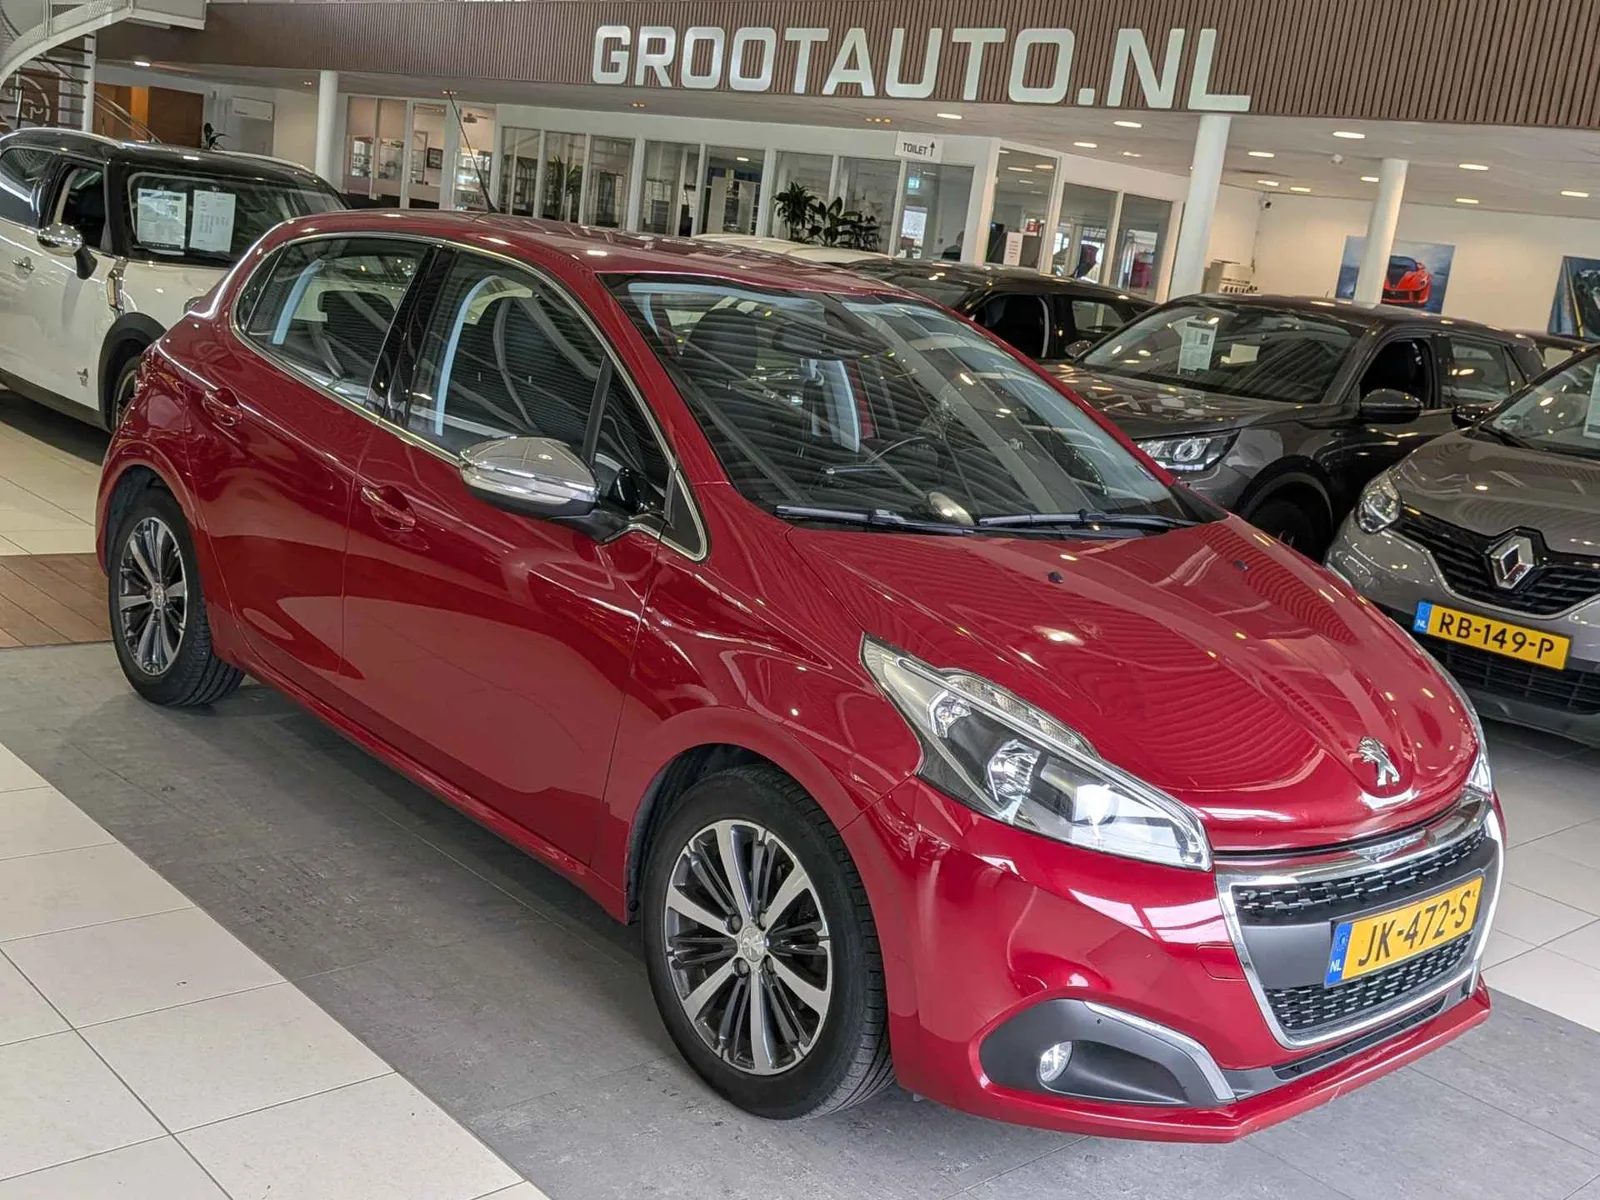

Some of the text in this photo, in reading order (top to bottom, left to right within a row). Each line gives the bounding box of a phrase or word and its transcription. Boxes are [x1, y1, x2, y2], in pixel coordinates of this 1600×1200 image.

[592, 25, 1251, 112] GROOTAUTO.NL
[903, 142, 928, 156] TOILET
[1416, 612, 1554, 660] NL RB-149-P
[1330, 890, 1470, 973] NL JK-472-S
